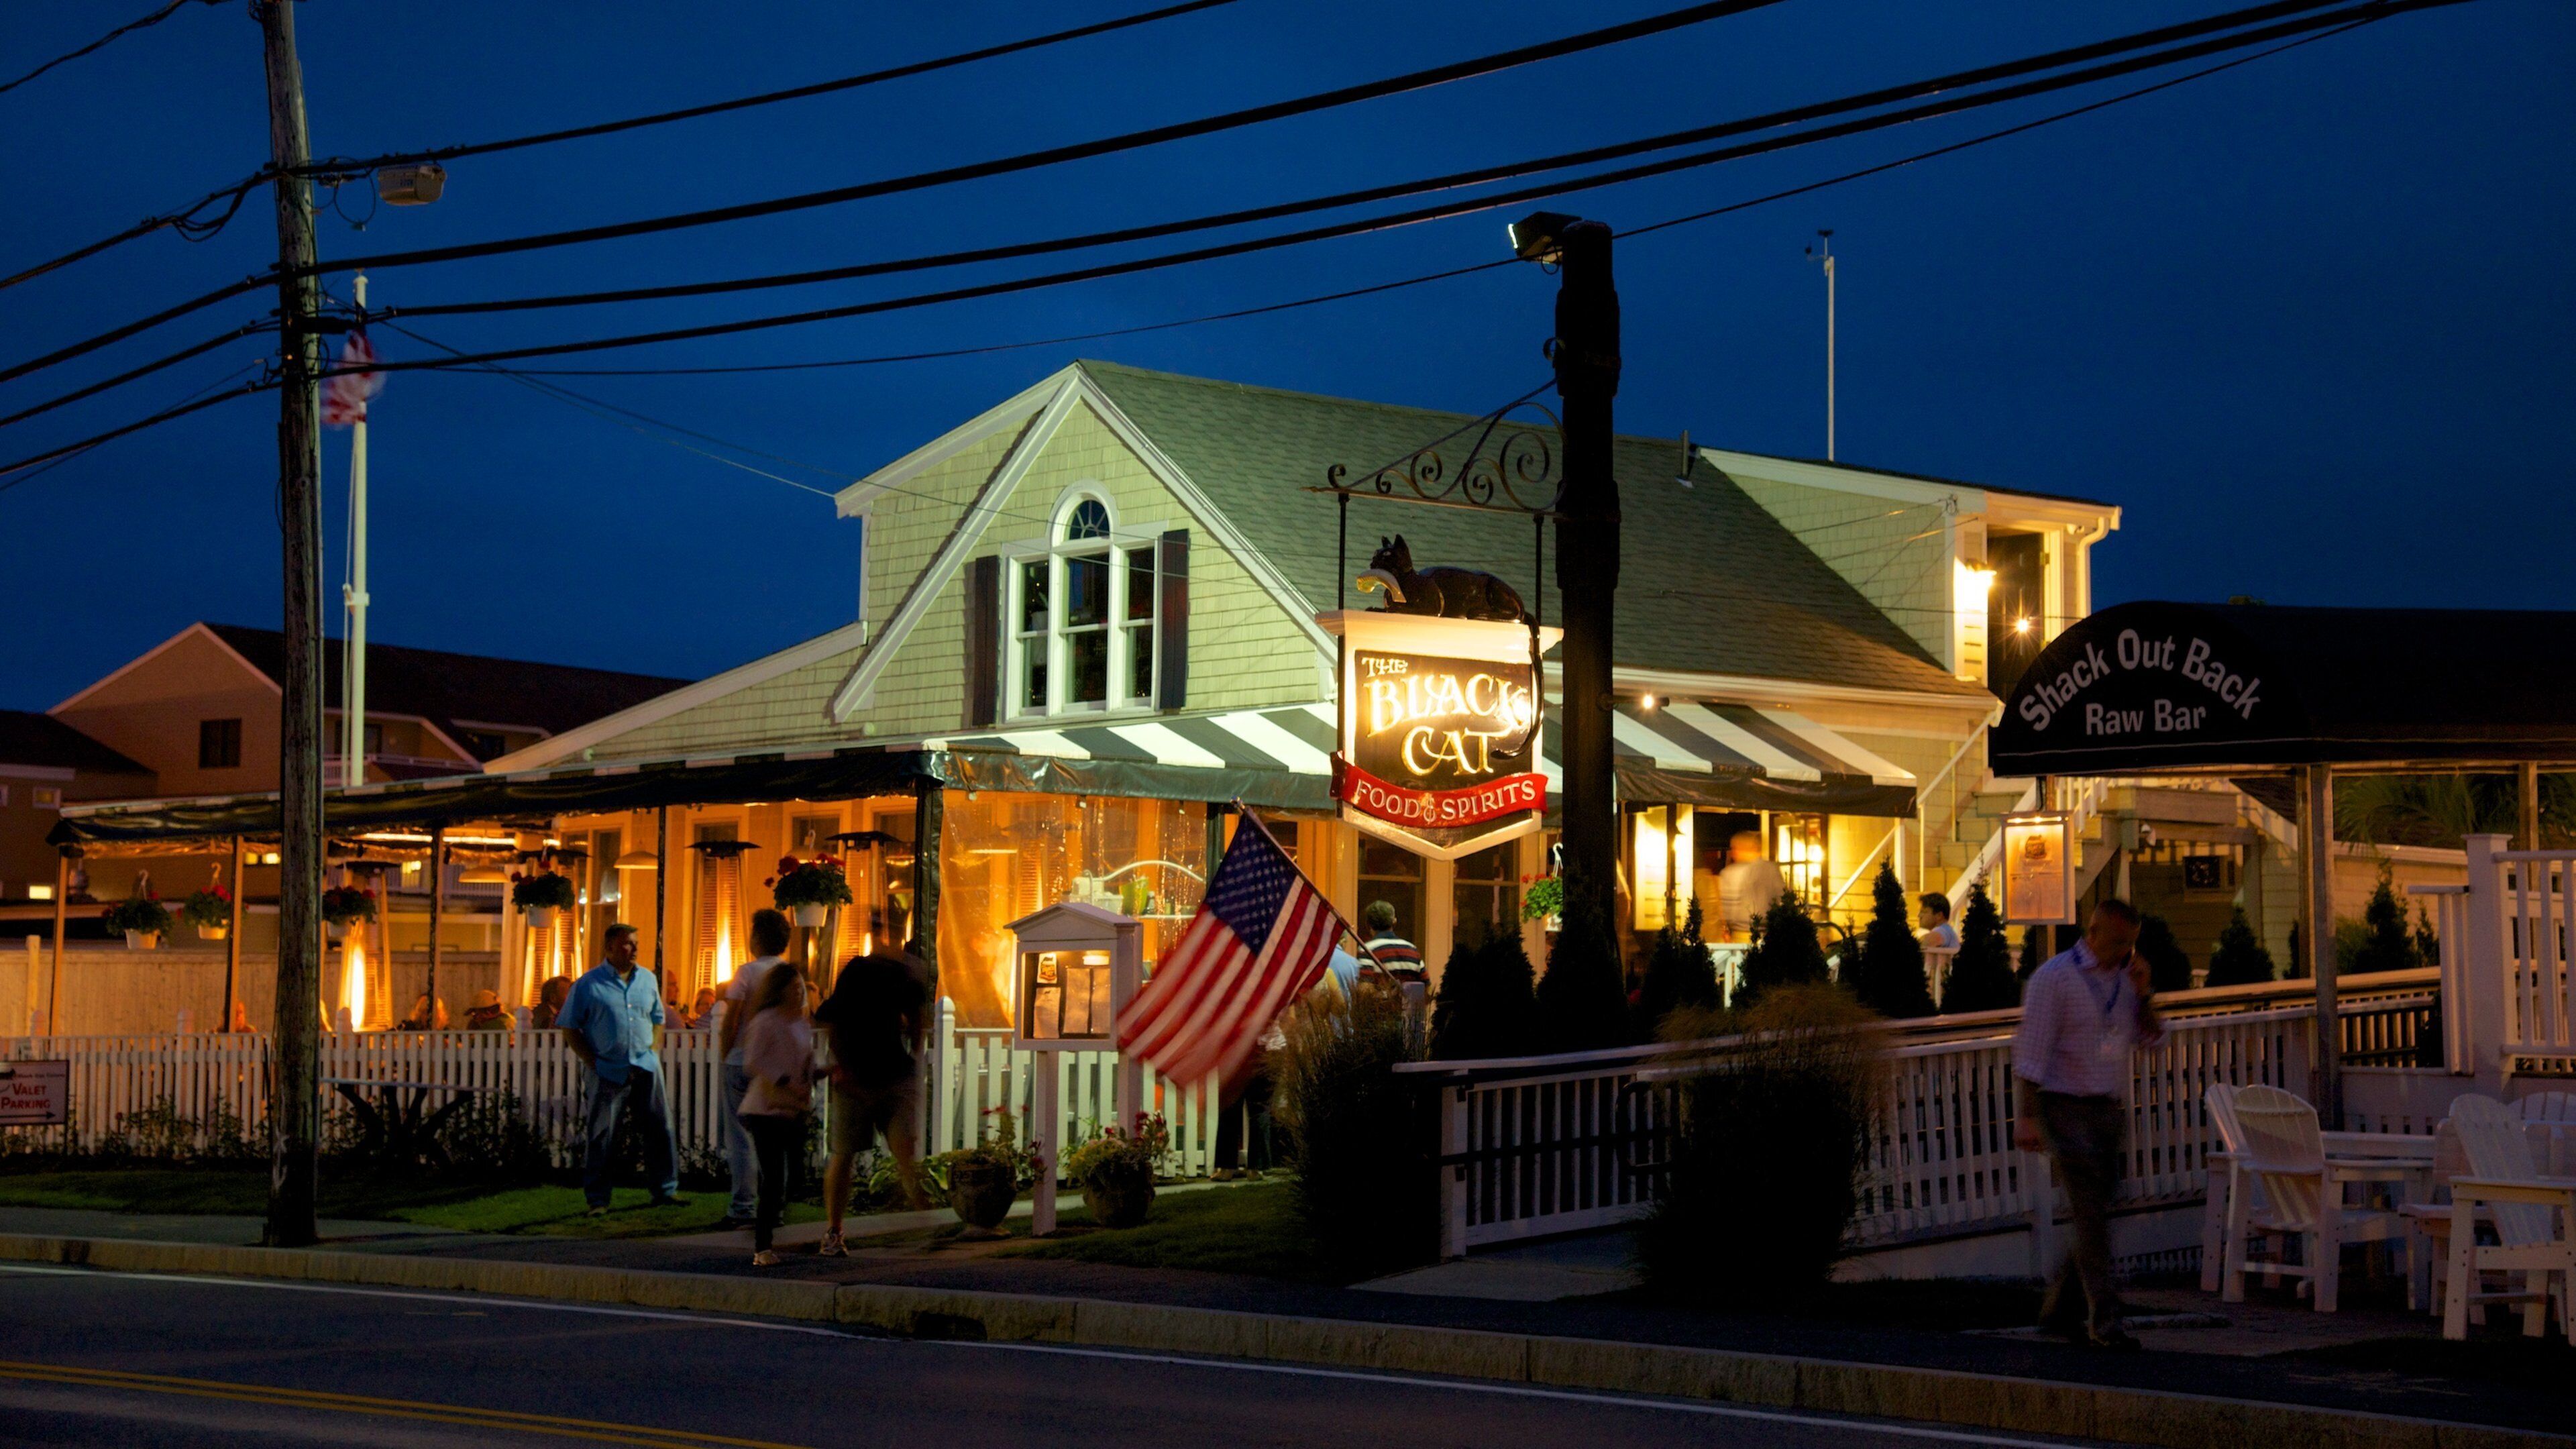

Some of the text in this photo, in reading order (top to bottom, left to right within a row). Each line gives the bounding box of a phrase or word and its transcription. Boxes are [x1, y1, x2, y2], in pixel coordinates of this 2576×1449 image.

[1362, 657, 1408, 678] THE
[2019, 629, 2261, 731] Shack Out Back
[1363, 673, 1528, 738] BLACK
[2086, 699, 2206, 735] Raw Bar
[1401, 726, 1505, 776] CAT
[1352, 779, 1421, 818] FOOD
[1441, 780, 1536, 820] SPIRITS
[1, 1096, 50, 1109] PARKING
[12, 1083, 46, 1095] VALET
